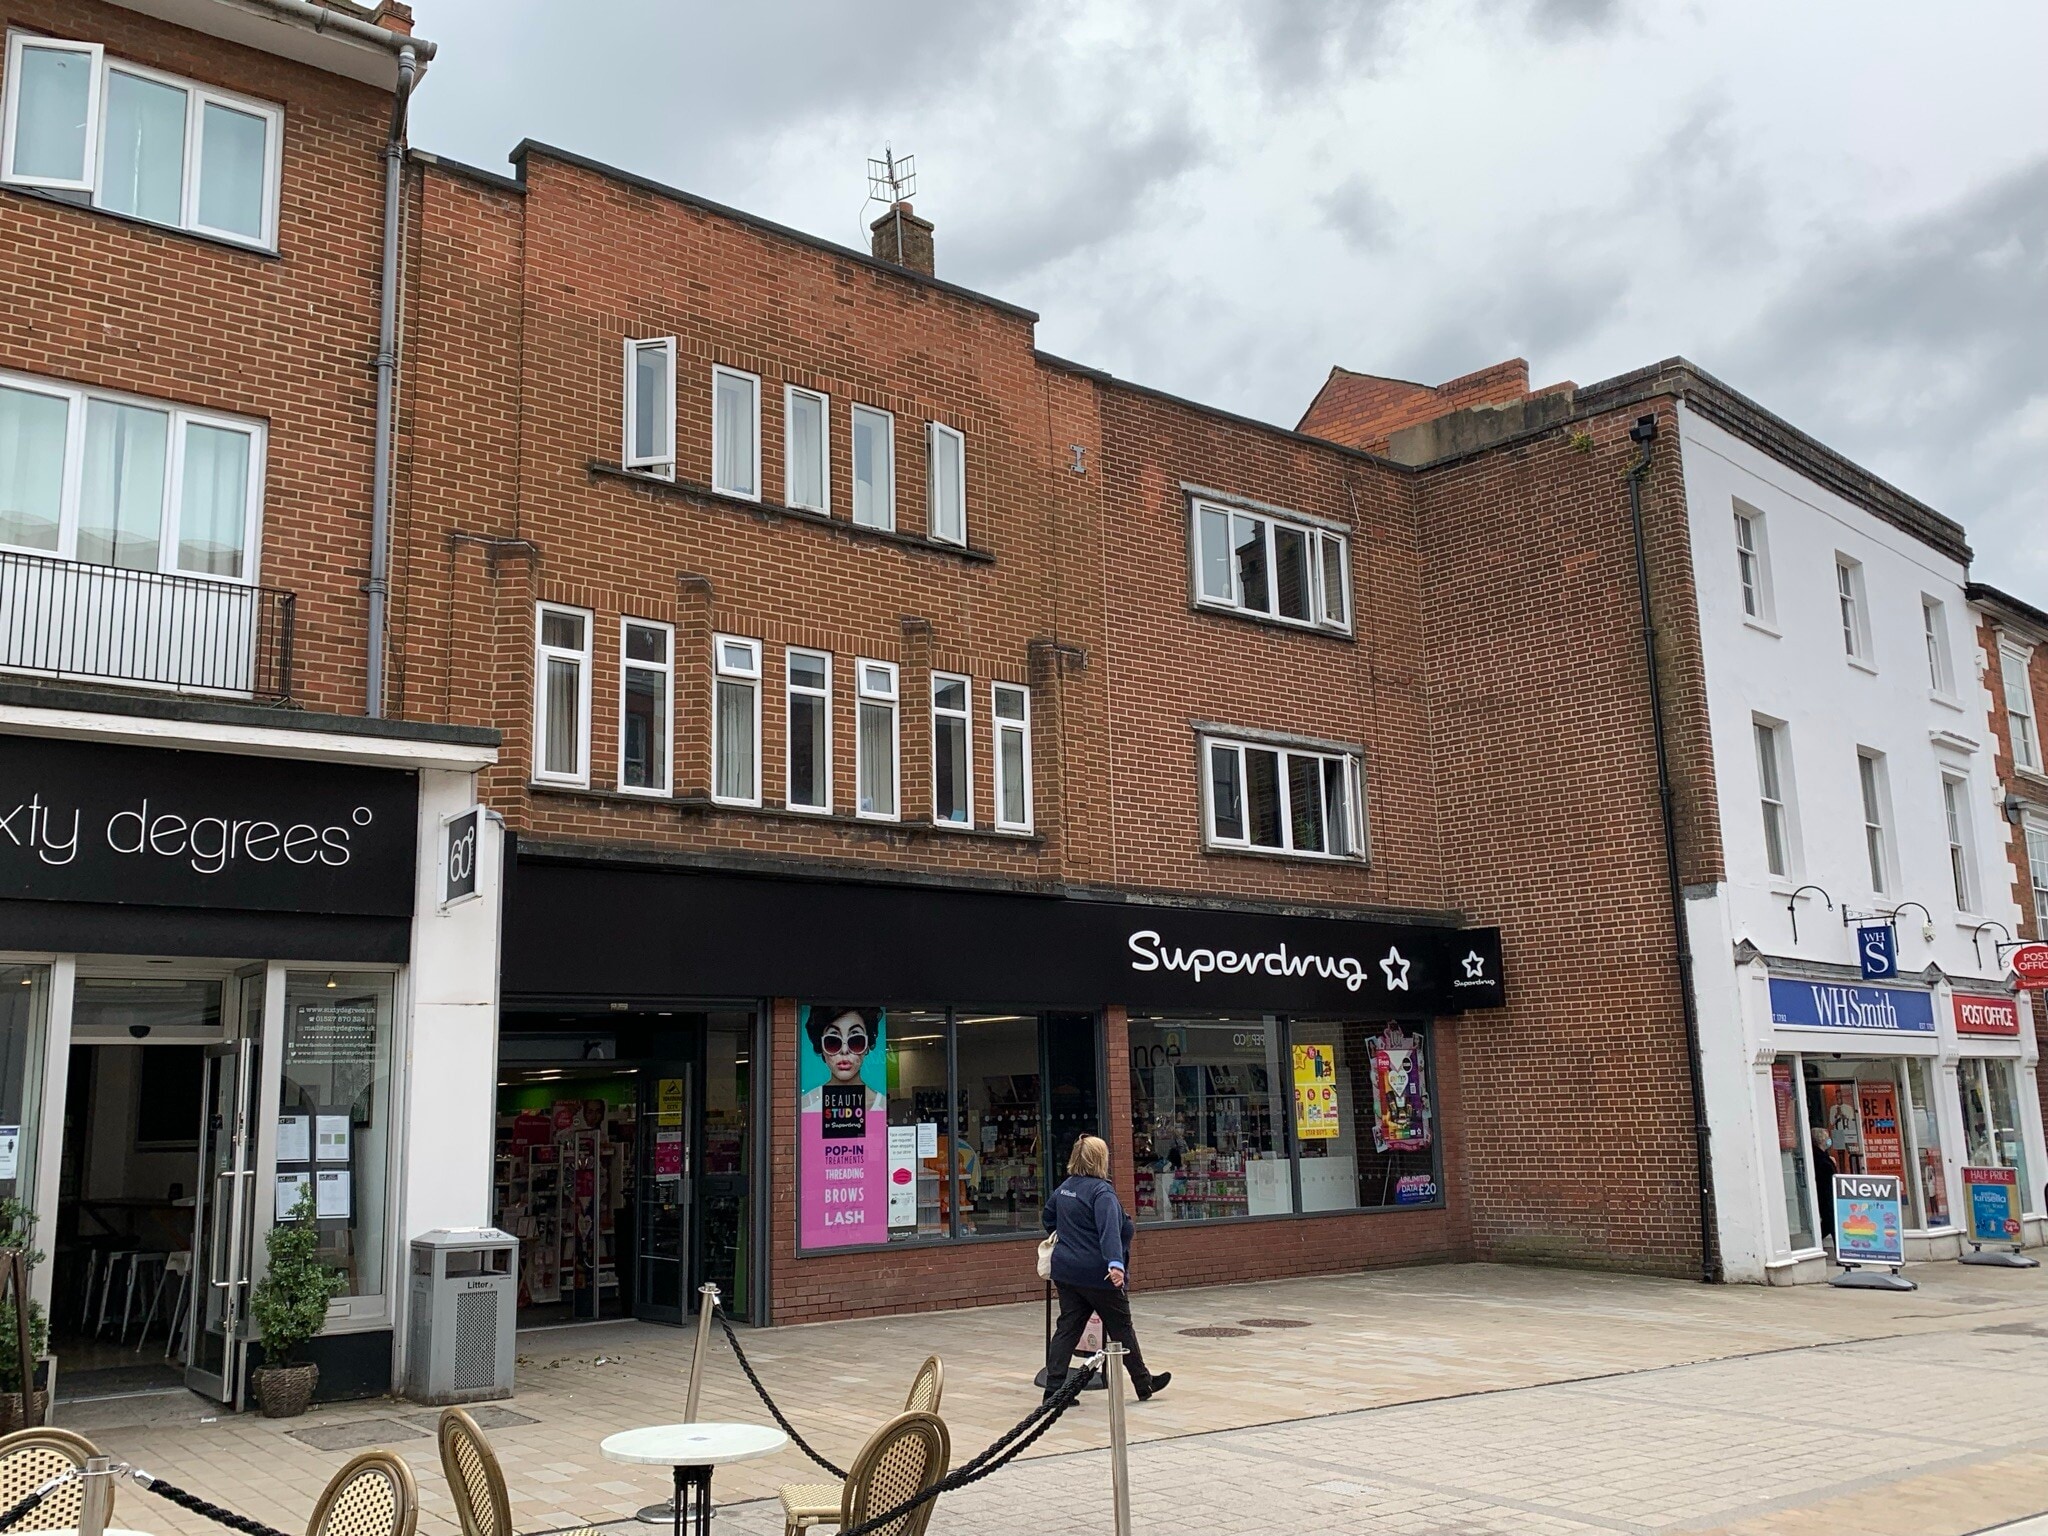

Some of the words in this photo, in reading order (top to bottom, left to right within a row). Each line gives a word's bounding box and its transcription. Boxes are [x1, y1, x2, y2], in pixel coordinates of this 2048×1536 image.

[1864, 932, 1885, 942] WH
[1128, 930, 1368, 991] Superdrug
[1865, 942, 1889, 973] S
[2023, 952, 2048, 961] POST
[1453, 979, 1496, 988] Superdrug
[1811, 986, 1899, 1029] WHSmith
[1961, 1004, 1983, 1025] POST
[1984, 1006, 2014, 1027] OFFICE
[825, 1093, 863, 1107] BEAUTY
[825, 1107, 863, 1119] STUDO
[1862, 1098, 1879, 1116] BE
[1885, 1098, 1894, 1116] A
[825, 1145, 864, 1156] POP-IN
[825, 1155, 865, 1165] TREATMENTS
[825, 1168, 864, 1180] THREADING
[1970, 1170, 1988, 1180] HALF
[1989, 1171, 2010, 1181] PRICE
[1402, 1184, 1418, 1193] DATA
[1419, 1183, 1437, 1196] £20
[1841, 1179, 1891, 1198] New
[825, 1187, 864, 1204] BROWS
[1974, 1193, 2006, 1204] kinsella
[825, 1210, 865, 1226] LASH
[467, 1281, 489, 1289] Litter
